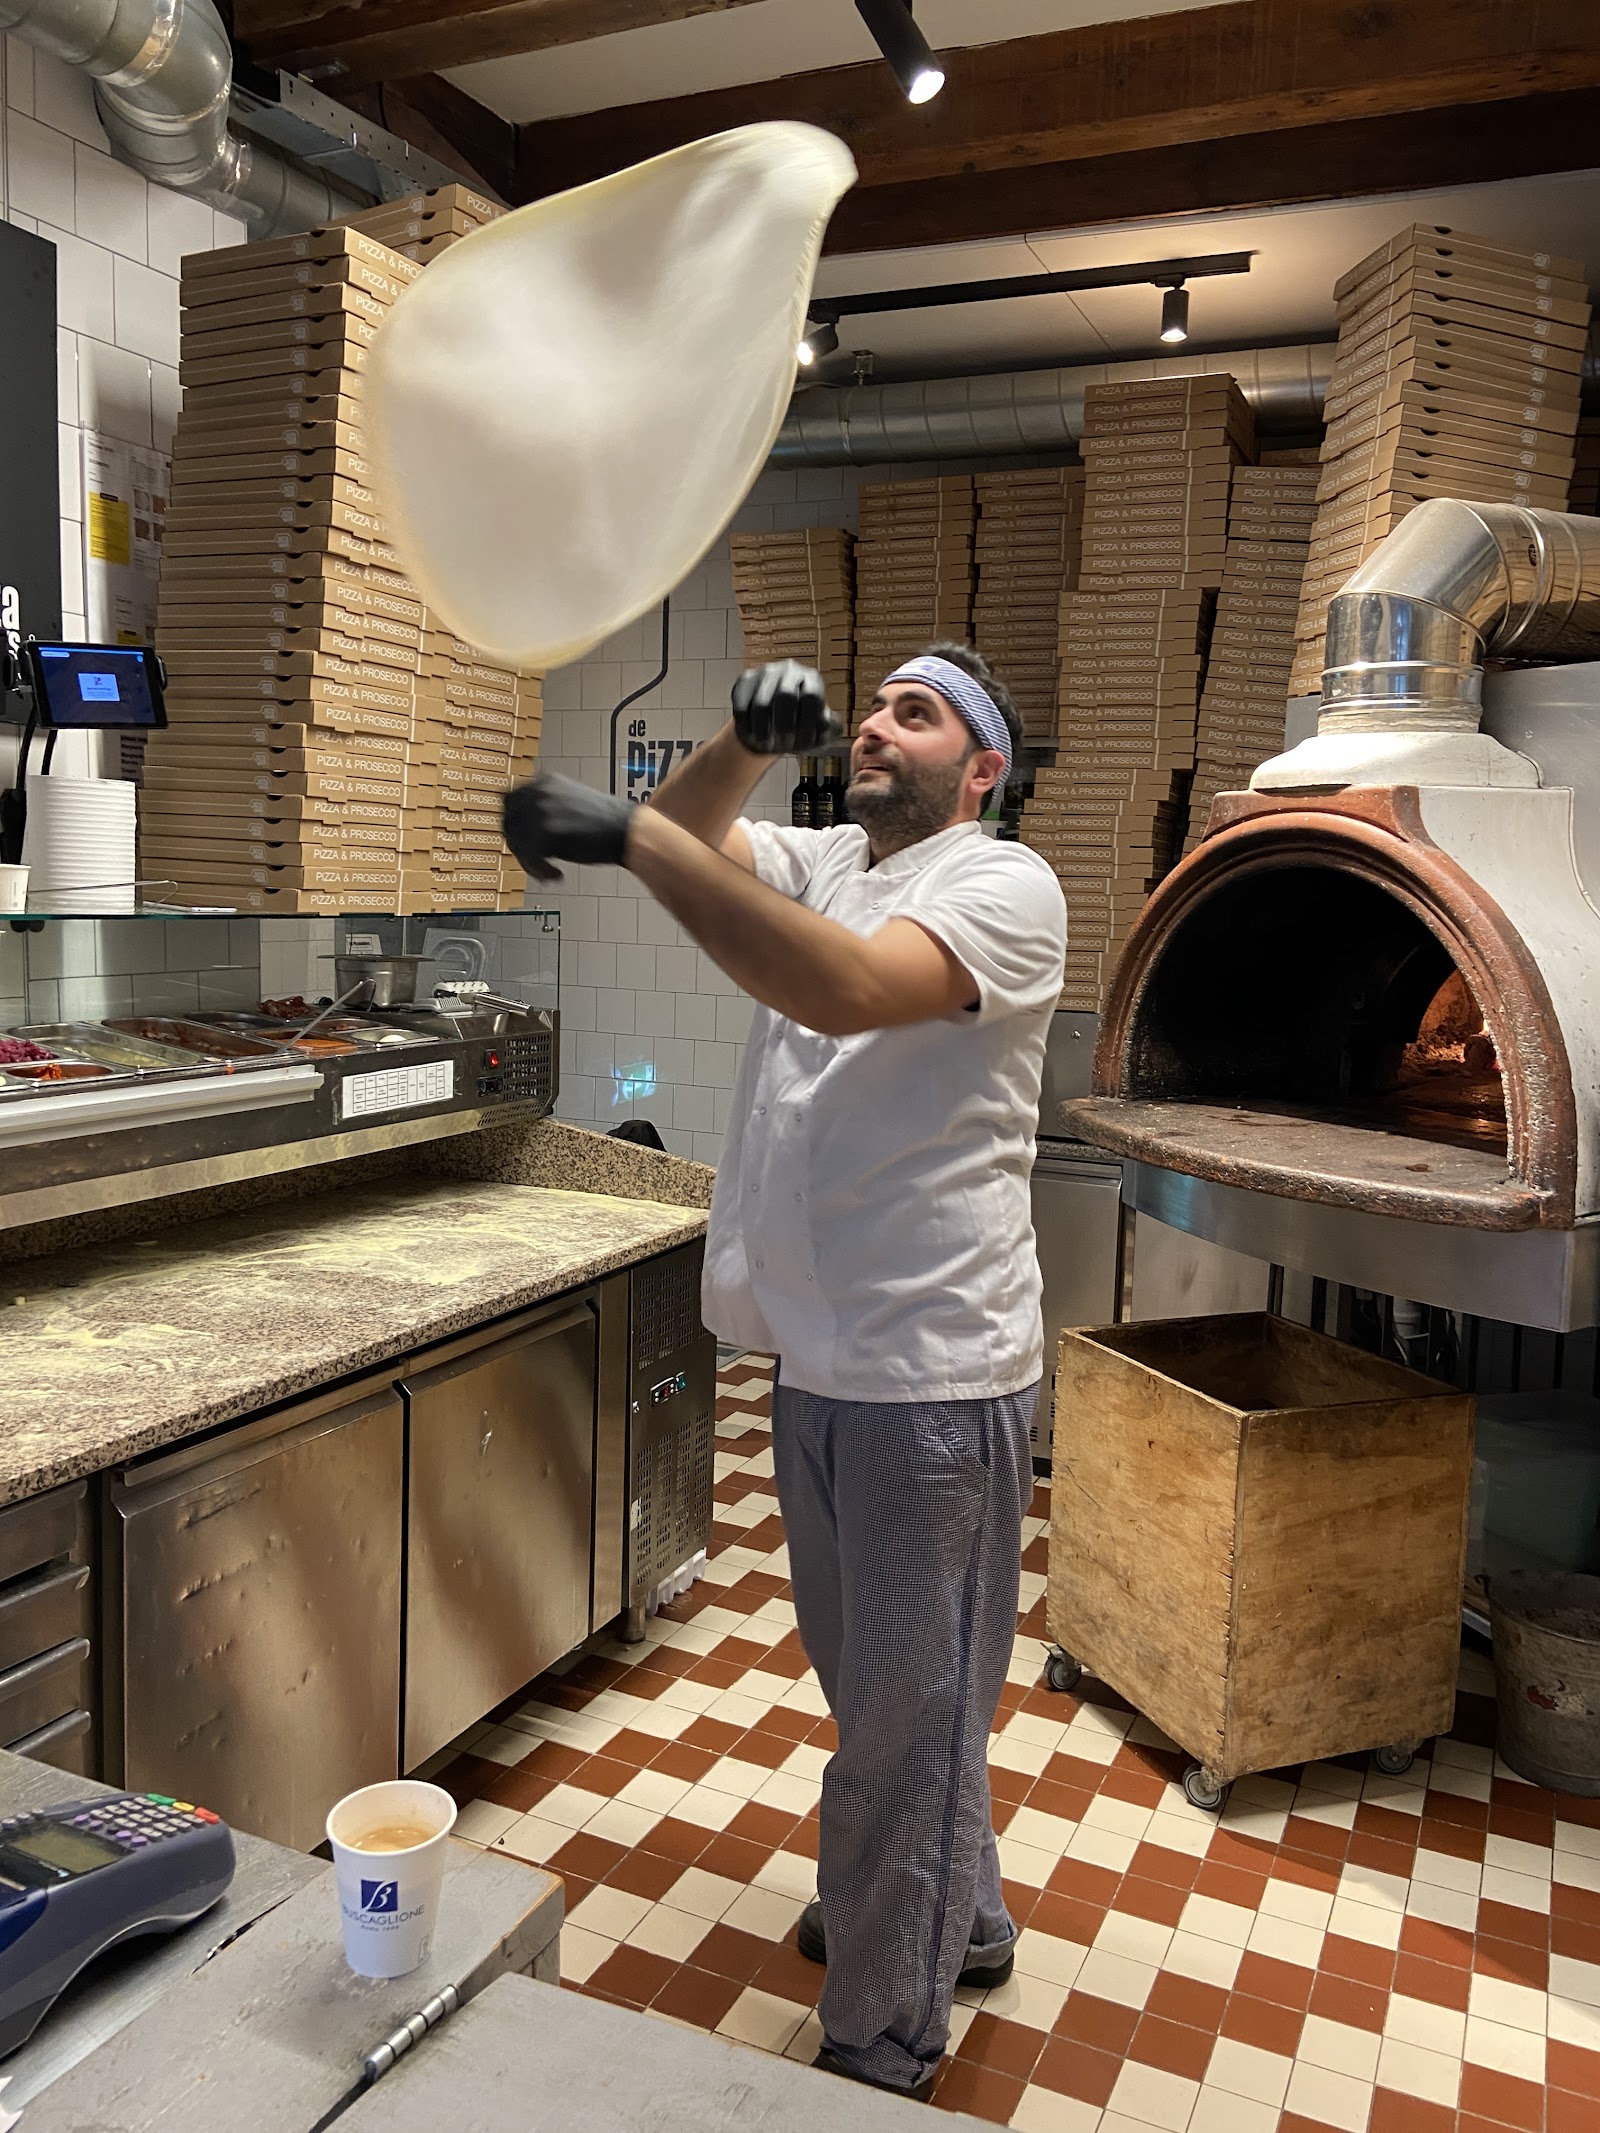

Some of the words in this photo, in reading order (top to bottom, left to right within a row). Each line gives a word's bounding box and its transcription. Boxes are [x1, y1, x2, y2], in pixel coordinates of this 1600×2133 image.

[358, 240, 386, 263] PIZZA
[389, 255, 396, 267] &
[1091, 440, 1115, 449] PIZZA
[1127, 435, 1178, 446] PROSECCO
[1096, 457, 1121, 466] PIZZA
[1132, 453, 1184, 464] PROSECCO
[1284, 472, 1321, 480] PROSEC
[1096, 493, 1120, 502] PIZZA
[1132, 489, 1183, 499] PROSECCO
[1242, 507, 1268, 515] PIZZA
[1280, 509, 1318, 518] PROSEC
[1093, 527, 1117, 535] PIZZA
[1129, 524, 1180, 533] PROSECCO
[1129, 558, 1180, 567] PROSECCO
[335, 561, 361, 578] PIZZA
[363, 569, 370, 580] &
[1126, 575, 1177, 584] PROSECCO
[337, 586, 363, 603] PIZZA
[365, 594, 372, 605] &
[374, 596, 419, 618] PROSECCO
[1108, 593, 1157, 602] PROSECCO
[1105, 611, 1155, 619] PROSECCO
[335, 611, 361, 627] PIZZA
[363, 618, 370, 629] &
[372, 620, 417, 640] PROSECCO
[1224, 632, 1249, 641] PIZZA
[1262, 635, 1298, 645] PROSEC
[332, 635, 358, 651] PIZZA
[360, 642, 367, 653] &
[369, 644, 414, 663] PROSECCO
[1107, 659, 1156, 667] PROSECCO
[326, 659, 351, 674] PIZZA
[354, 664, 360, 675] &
[362, 666, 408, 685] PROSECCO
[323, 683, 350, 698] PIZZA
[352, 688, 359, 699] &
[361, 690, 409, 708] PROSECCO
[446, 684, 467, 696] PIZZA
[469, 688, 474, 698] &
[476, 690, 513, 706] PROSECCO
[1211, 699, 1236, 709] PIZZA
[1248, 703, 1285, 713] PROSEC
[326, 708, 352, 722] PIZZA
[354, 712, 361, 723] &
[363, 714, 408, 731] PROSECCO
[445, 705, 465, 718] PIZZA
[467, 709, 473, 719] &
[474, 711, 512, 726] PROSECCO
[1210, 714, 1235, 725] PIZZA
[1247, 719, 1284, 731] PROSEC
[628, 719, 646, 737] de
[316, 731, 342, 744] PIZZA
[345, 735, 352, 745] &
[354, 736, 402, 752] PROSECCO
[317, 755, 343, 767] PIZZA
[346, 758, 352, 768] &
[354, 759, 401, 774] PROSECCO
[440, 748, 460, 760] PIZZA
[462, 752, 467, 761] &
[469, 753, 506, 767] PROSECCO
[442, 770, 463, 781] PIZZA
[464, 773, 470, 782] &
[472, 774, 508, 787] PROSECCO
[320, 779, 345, 791] PIZZA
[347, 782, 353, 792] &
[356, 783, 400, 797] PROSECCO
[314, 802, 340, 814] PIZZA
[342, 804, 348, 814] &
[351, 805, 396, 819] PROSECCO
[1063, 819, 1111, 827] PROSECCO
[313, 826, 338, 838] PIZZA
[341, 828, 348, 838] &
[350, 829, 396, 842] PROSECCO
[437, 832, 456, 842] PIZZA
[458, 833, 463, 842] &
[465, 834, 500, 844] PROSECCO
[314, 849, 339, 860] PIZZA
[341, 850, 348, 860] &
[350, 851, 395, 863] PROSECCO
[433, 852, 452, 862] PIZZA
[454, 853, 459, 862] &
[461, 854, 496, 863] PROSECCO
[316, 871, 341, 882] PIZZA
[343, 872, 349, 882] &
[352, 873, 396, 884] PROSECCO
[310, 895, 336, 905] PIZZA
[339, 895, 346, 905] &
[348, 896, 395, 906] PROSECCO
